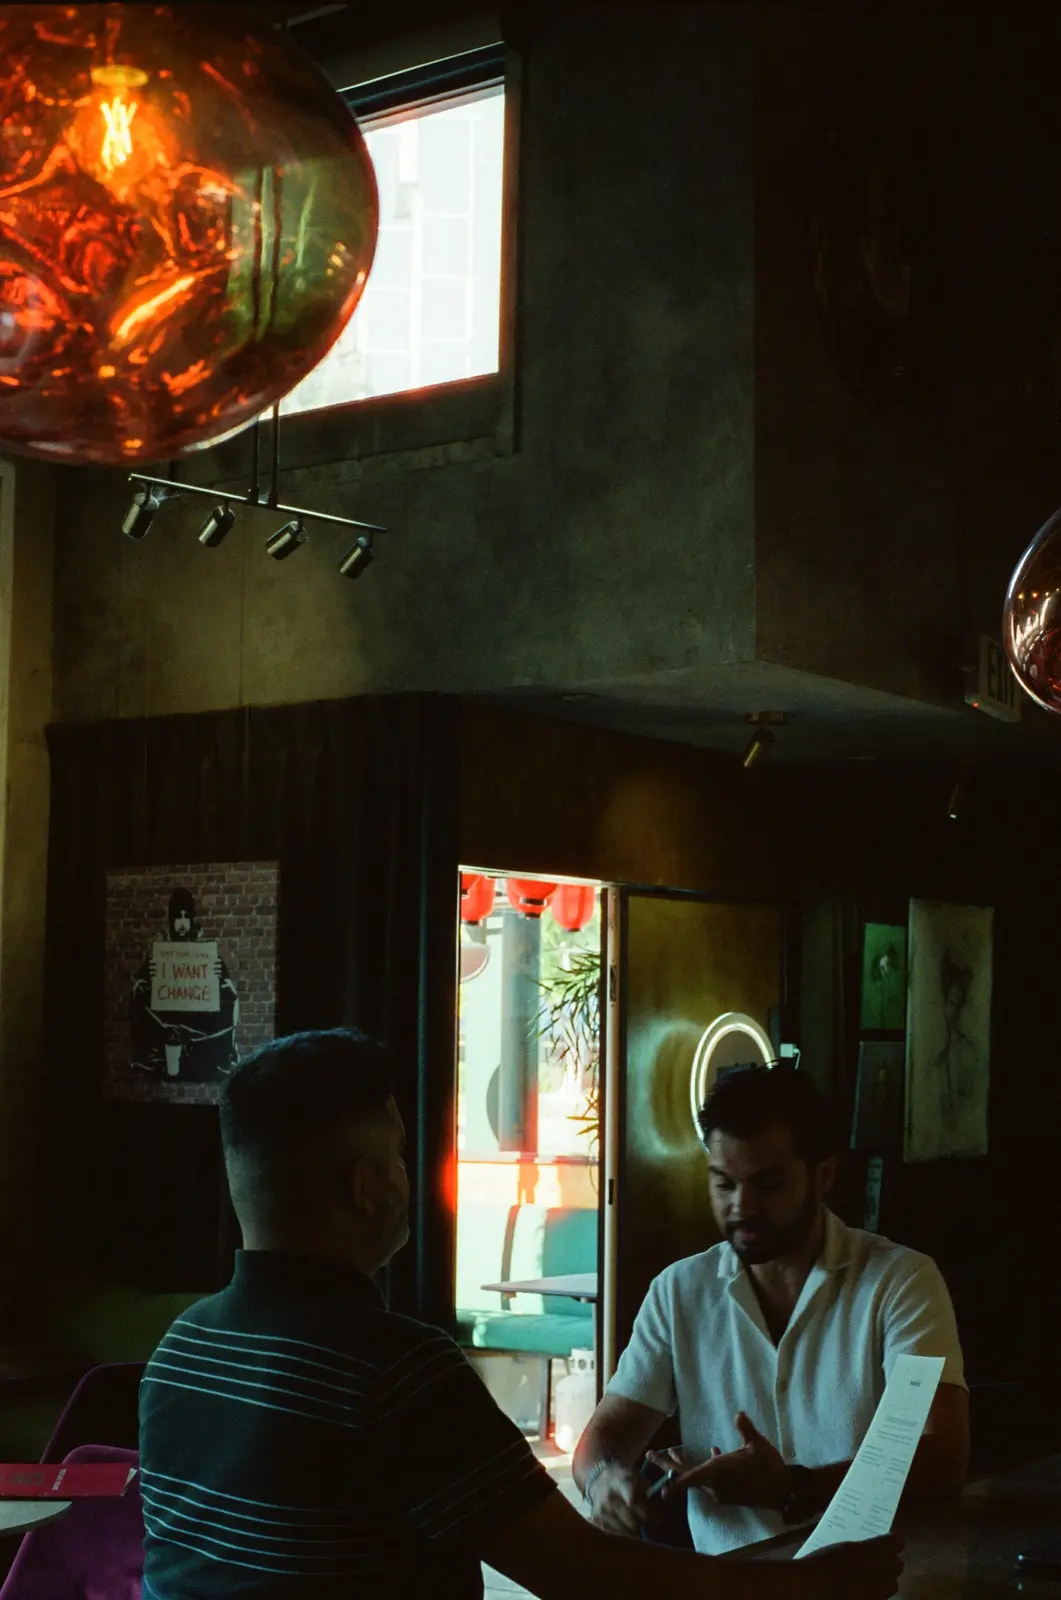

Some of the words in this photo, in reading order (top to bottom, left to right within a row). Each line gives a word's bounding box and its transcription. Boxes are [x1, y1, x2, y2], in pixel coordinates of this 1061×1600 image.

[161, 962, 166, 980] I
[172, 963, 208, 981] WANT
[158, 984, 211, 1001] CHANGE
